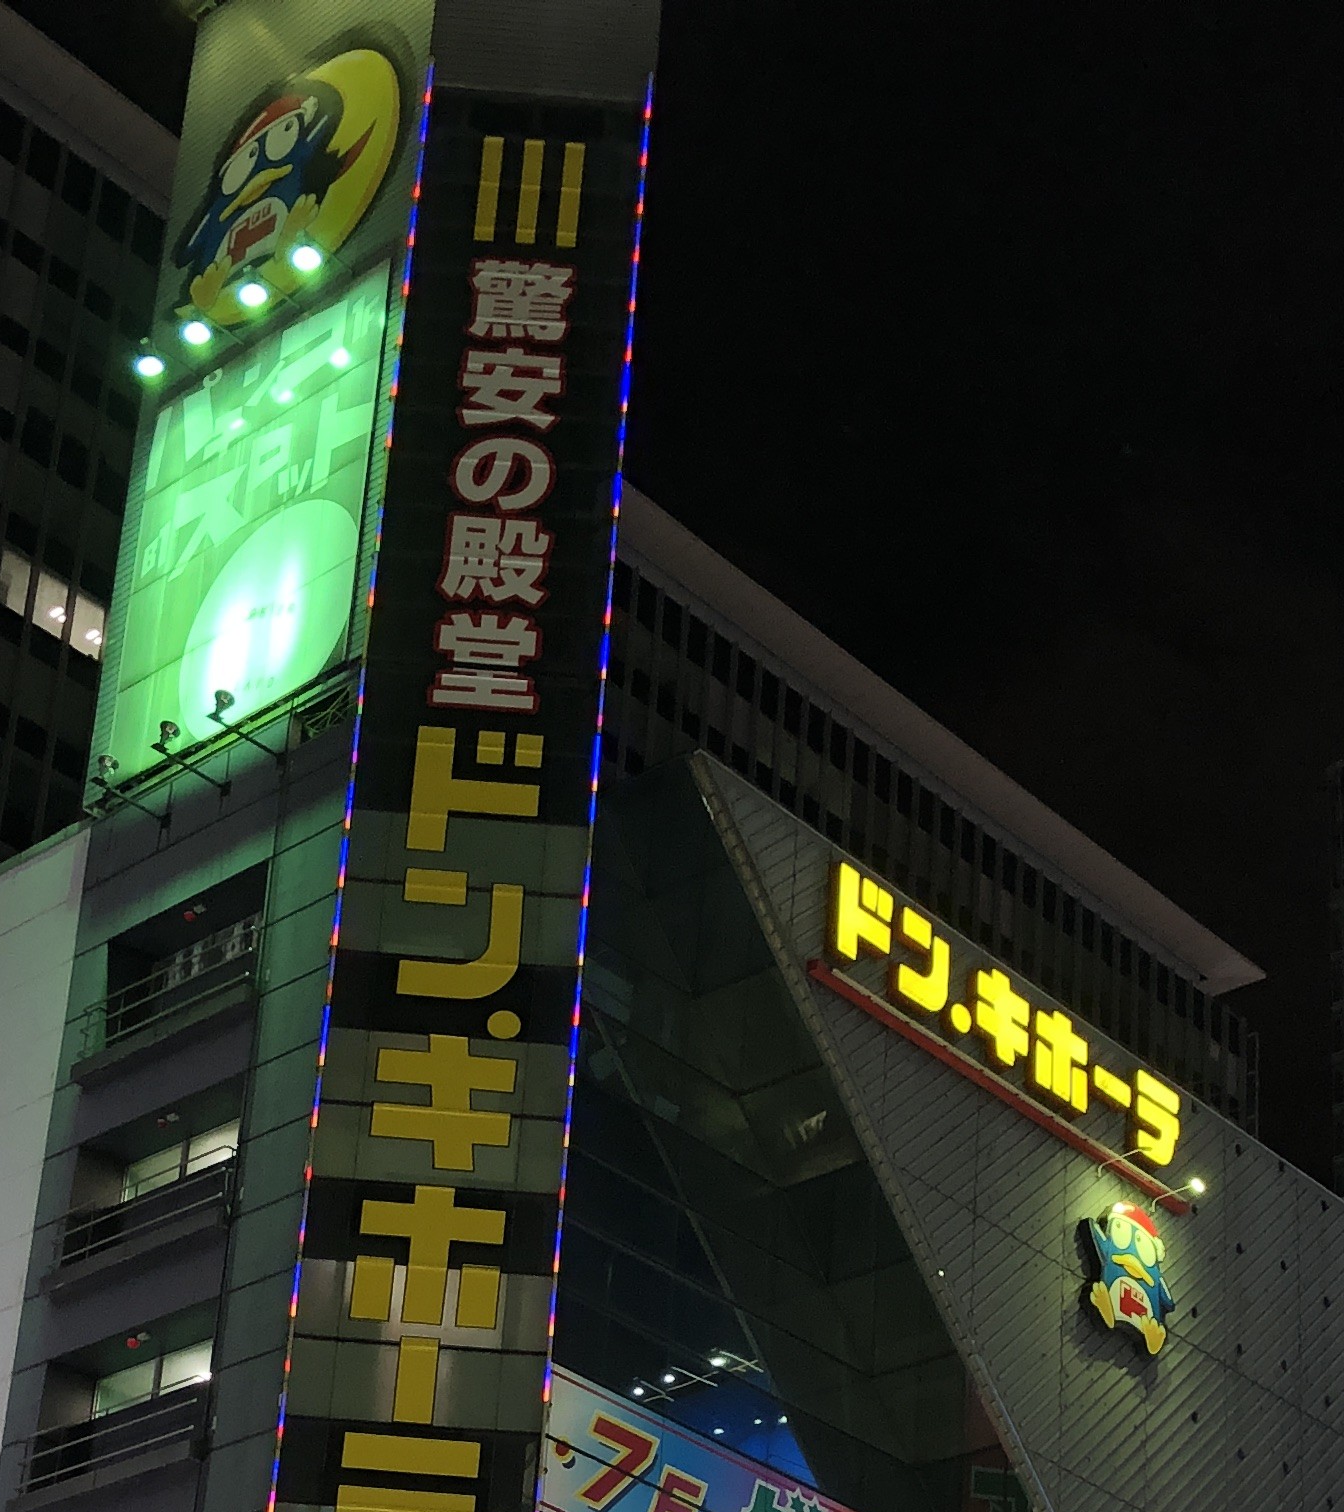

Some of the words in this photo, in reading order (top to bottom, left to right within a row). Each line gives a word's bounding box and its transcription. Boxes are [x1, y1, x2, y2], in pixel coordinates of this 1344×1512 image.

[168, 392, 373, 582] スロット
[427, 259, 575, 712] 驚安の殿堂
